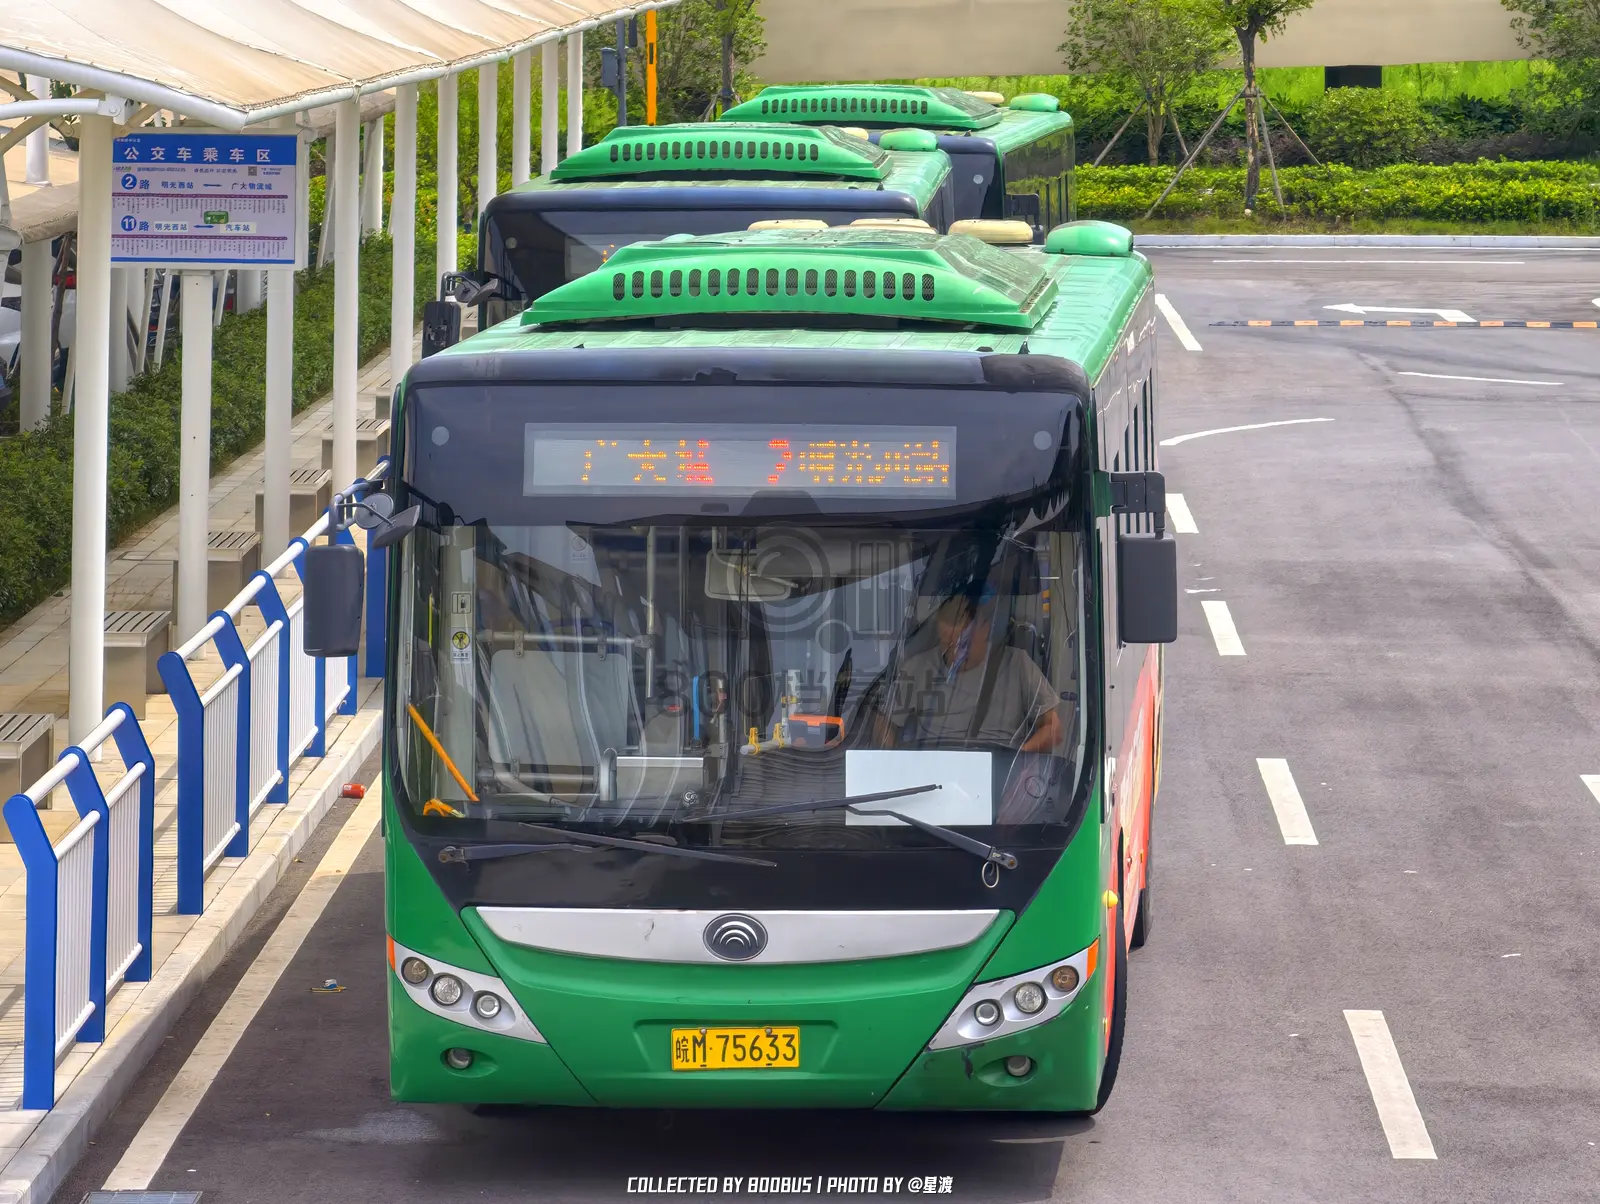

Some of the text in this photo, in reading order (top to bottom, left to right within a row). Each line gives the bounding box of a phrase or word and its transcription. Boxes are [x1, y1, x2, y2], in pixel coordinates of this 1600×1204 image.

[123, 146, 271, 163] 公交车乘车区
[154, 223, 188, 231] 明光西站
[225, 223, 251, 232] 汽车站
